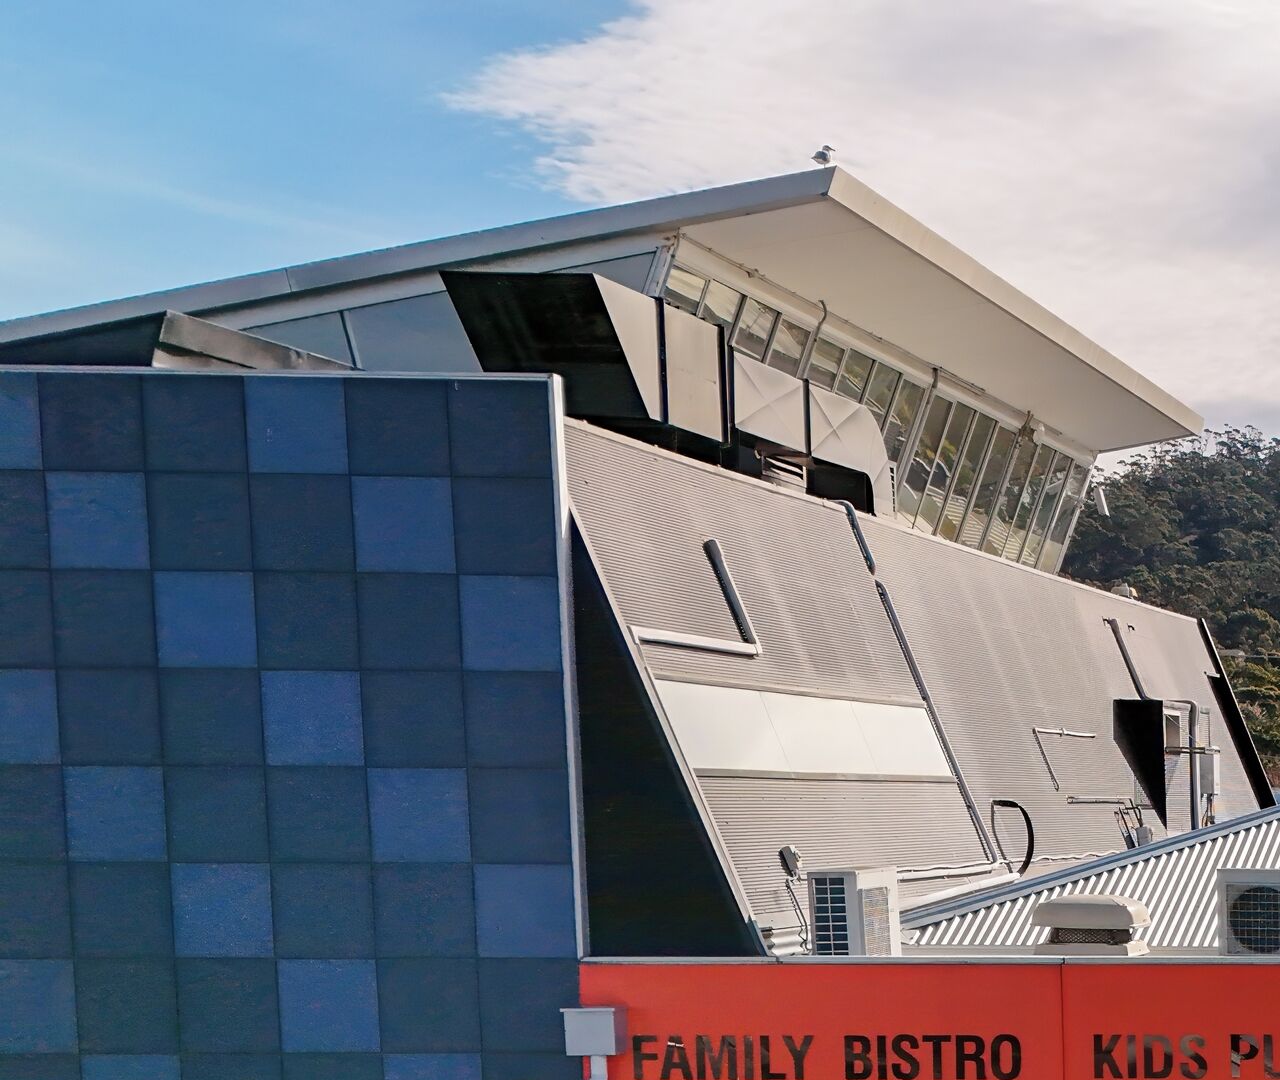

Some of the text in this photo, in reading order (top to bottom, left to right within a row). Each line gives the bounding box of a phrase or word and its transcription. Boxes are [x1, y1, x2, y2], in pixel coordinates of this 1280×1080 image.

[632, 1033, 1022, 1080] FAMILY BISTRO
[1093, 1033, 1208, 1080] KIDS
